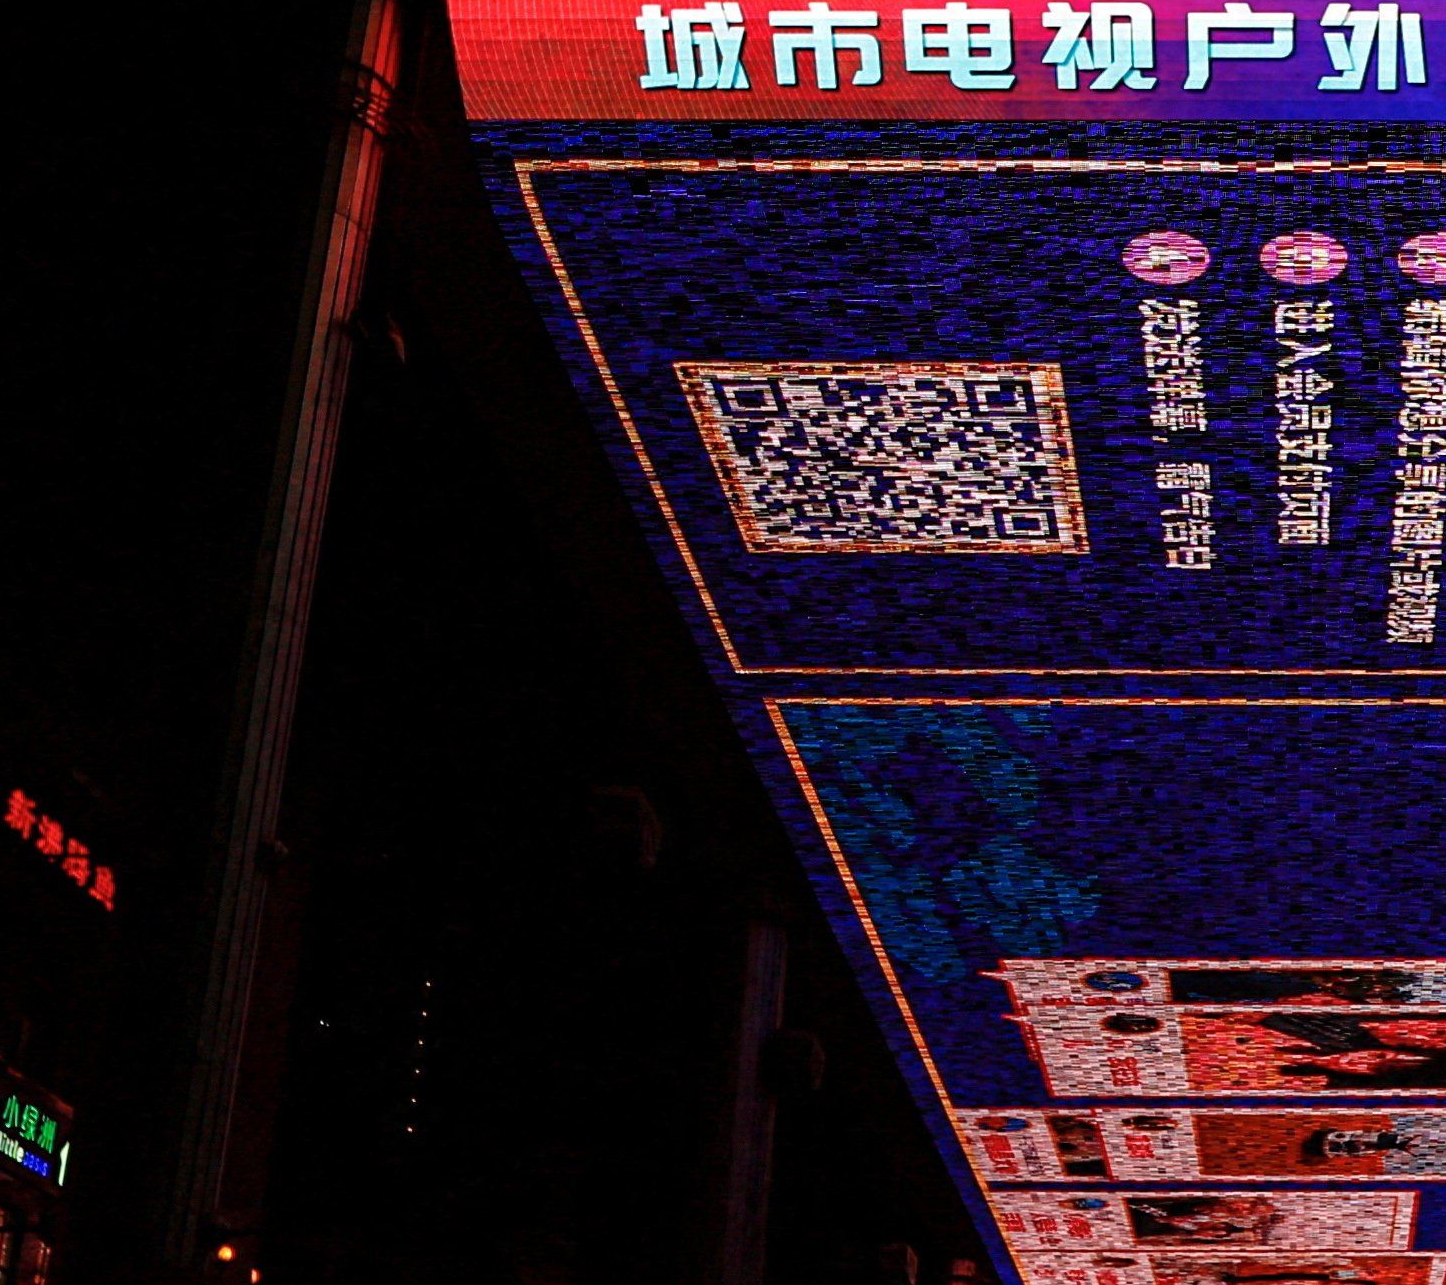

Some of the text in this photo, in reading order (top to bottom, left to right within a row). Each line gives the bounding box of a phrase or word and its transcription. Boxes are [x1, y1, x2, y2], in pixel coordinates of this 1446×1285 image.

[1274, 299, 1334, 545] 进入会员支付页面
